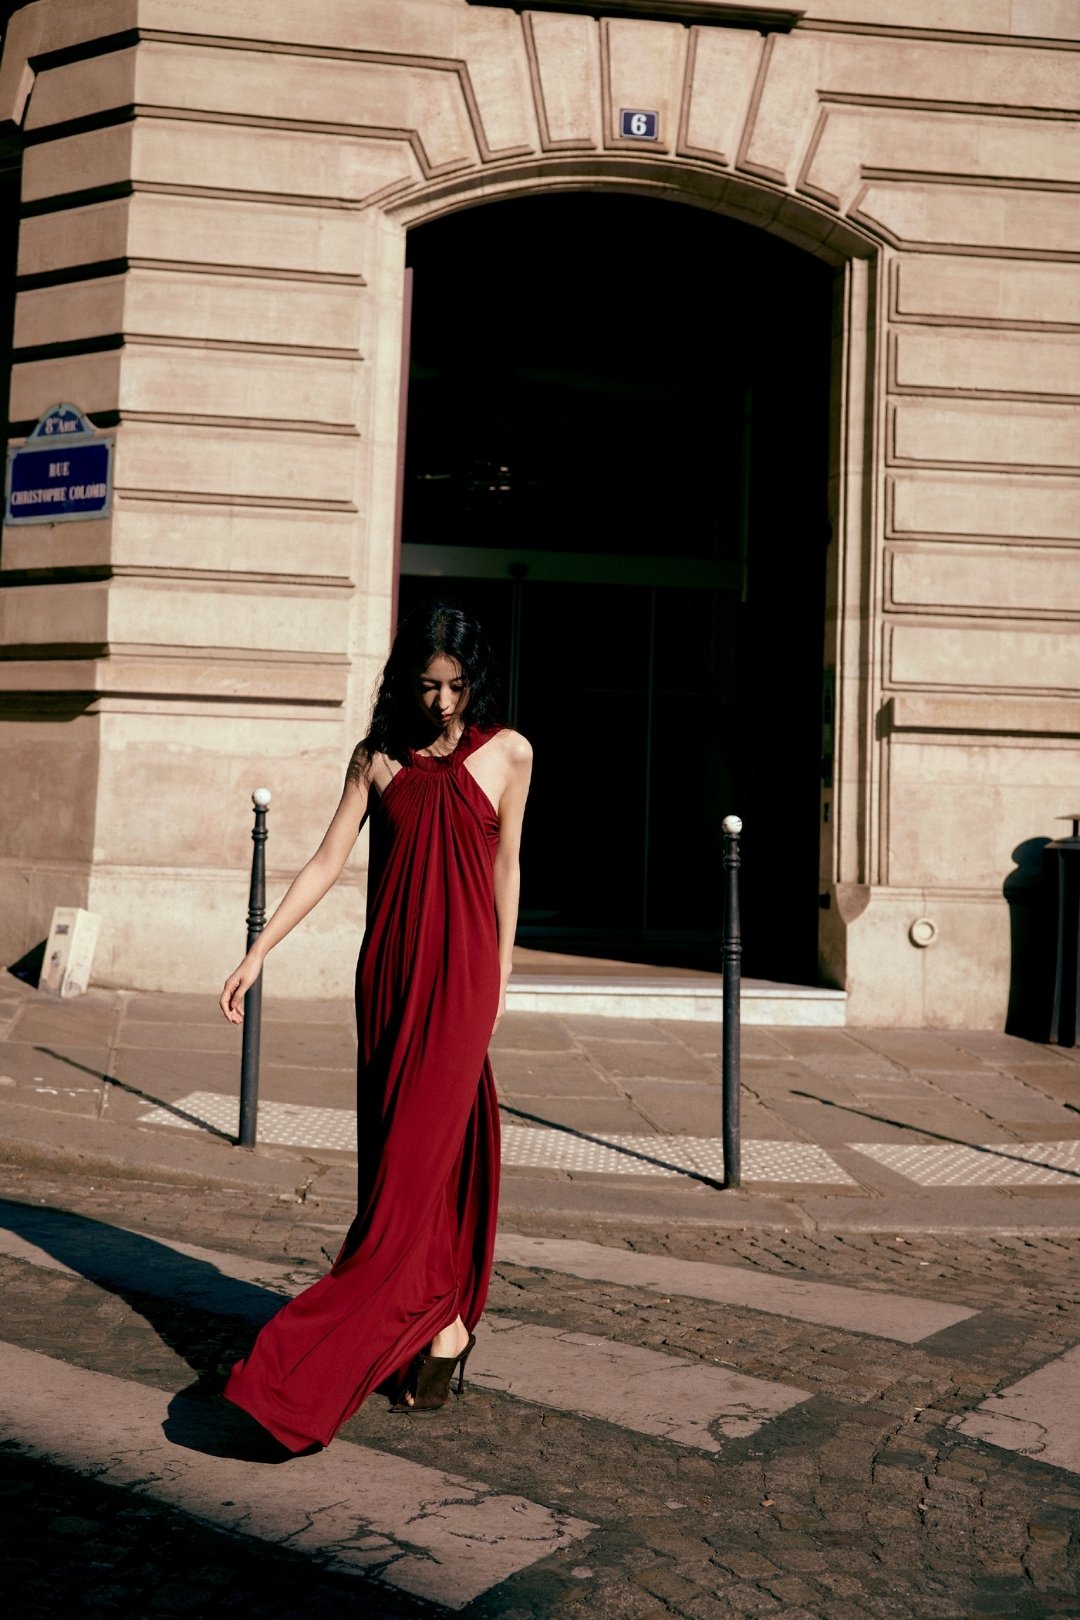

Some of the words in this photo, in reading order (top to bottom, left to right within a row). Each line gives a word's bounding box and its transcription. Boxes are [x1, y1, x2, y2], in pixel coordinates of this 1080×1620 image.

[631, 113, 647, 136] 6
[48, 461, 70, 478] RUE
[11, 487, 67, 506] CHRISTOPHE
[68, 483, 107, 501] COLOMB
